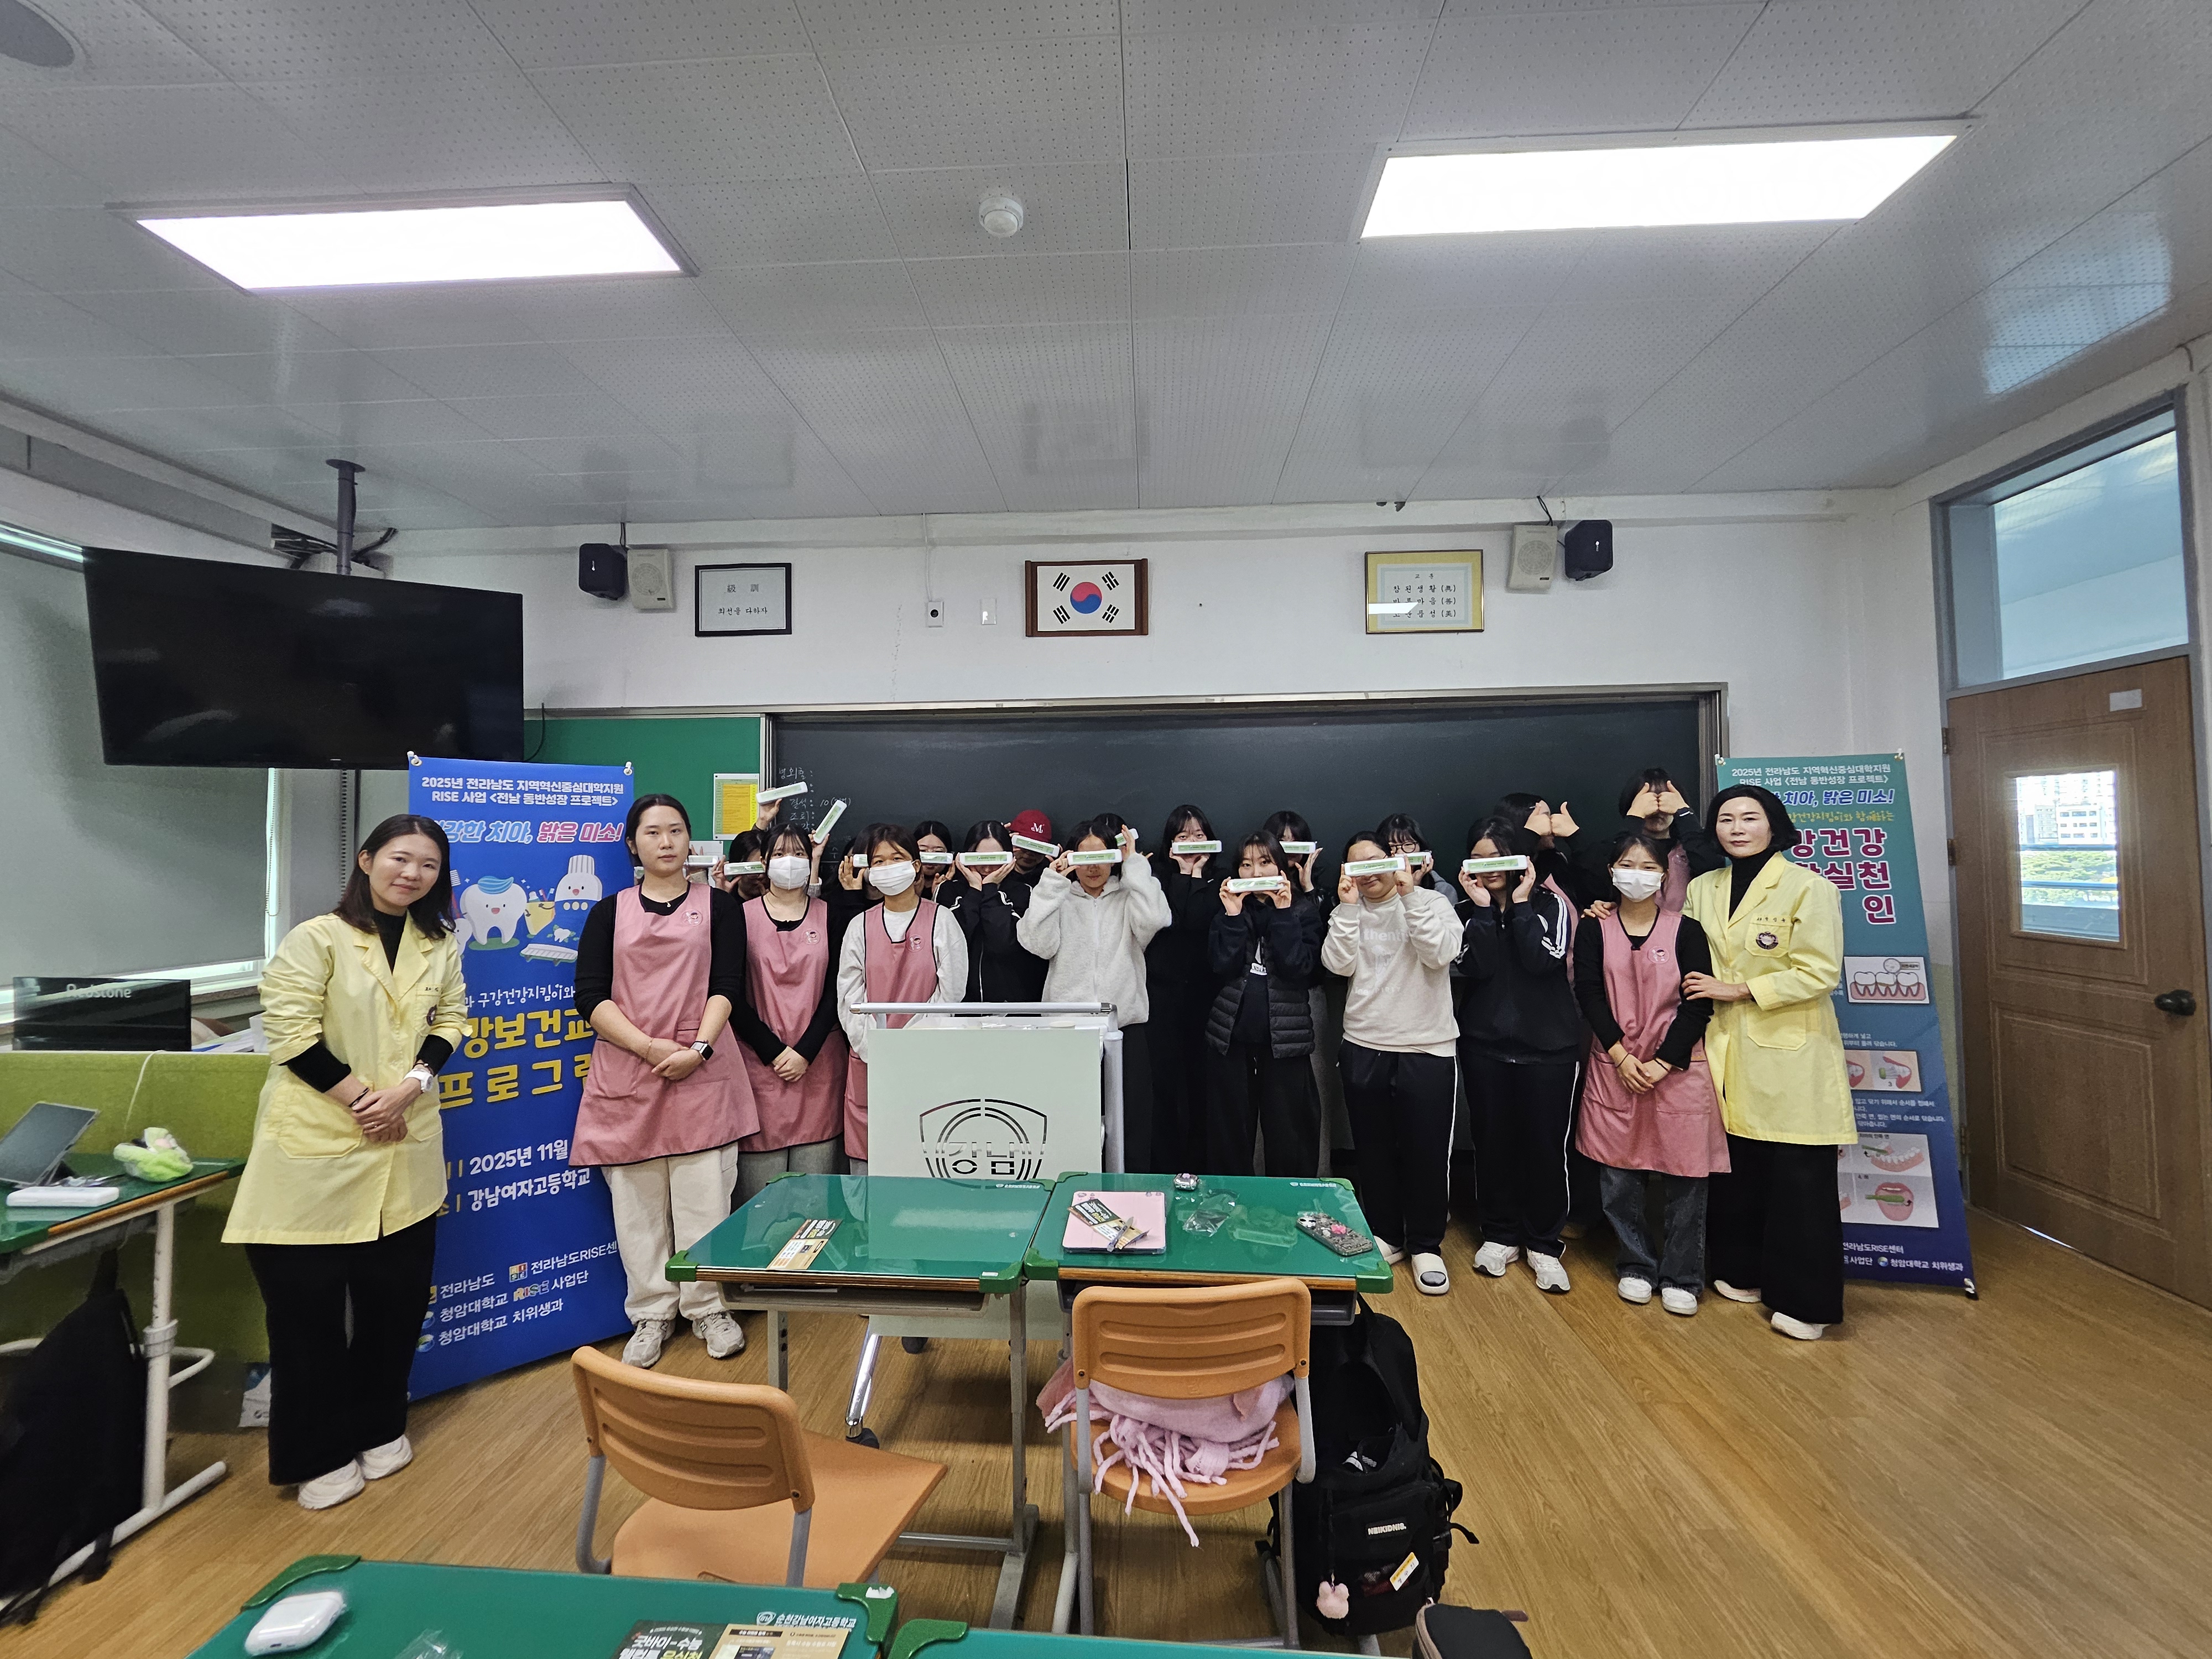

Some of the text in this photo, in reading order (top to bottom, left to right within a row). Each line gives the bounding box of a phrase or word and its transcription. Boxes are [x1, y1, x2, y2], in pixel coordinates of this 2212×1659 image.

[718, 606, 768, 616] 최선을 다하자
[1731, 763, 1892, 778] 2025년 전라남도 지역혁신중심대학지원
[1764, 777, 1782, 786] 사업
[1809, 775, 1846, 785] 동반성장
[421, 776, 624, 795] 2025년 전라남도 지역혁신중심대학지원
[431, 792, 619, 807] RISE 사업 <전남 동반성장 프로젝트>
[1783, 790, 1819, 808] 치아,
[1822, 790, 1854, 806] 밝은
[1856, 788, 1895, 805] 미소!
[434, 820, 625, 845] 강한 치아, 밝은 미소!
[1862, 894, 1897, 925] 인
[469, 1145, 532, 1176] 2025년
[536, 1139, 568, 1162] 11월
[467, 1167, 591, 1212] 강남여자고등학교
[530, 1240, 618, 1275] 전라남도RISE센
[1850, 1255, 1874, 1266] 사업단
[1890, 1258, 1964, 1272] 청암대학교 치위생과
[440, 1272, 495, 1300] 전라남도
[439, 1270, 589, 1323] 청암대학교 RISE 사업단
[438, 1297, 564, 1347] 청암대학교 치위생과
[775, 1612, 857, 1629] 순천강남여자고등학교
